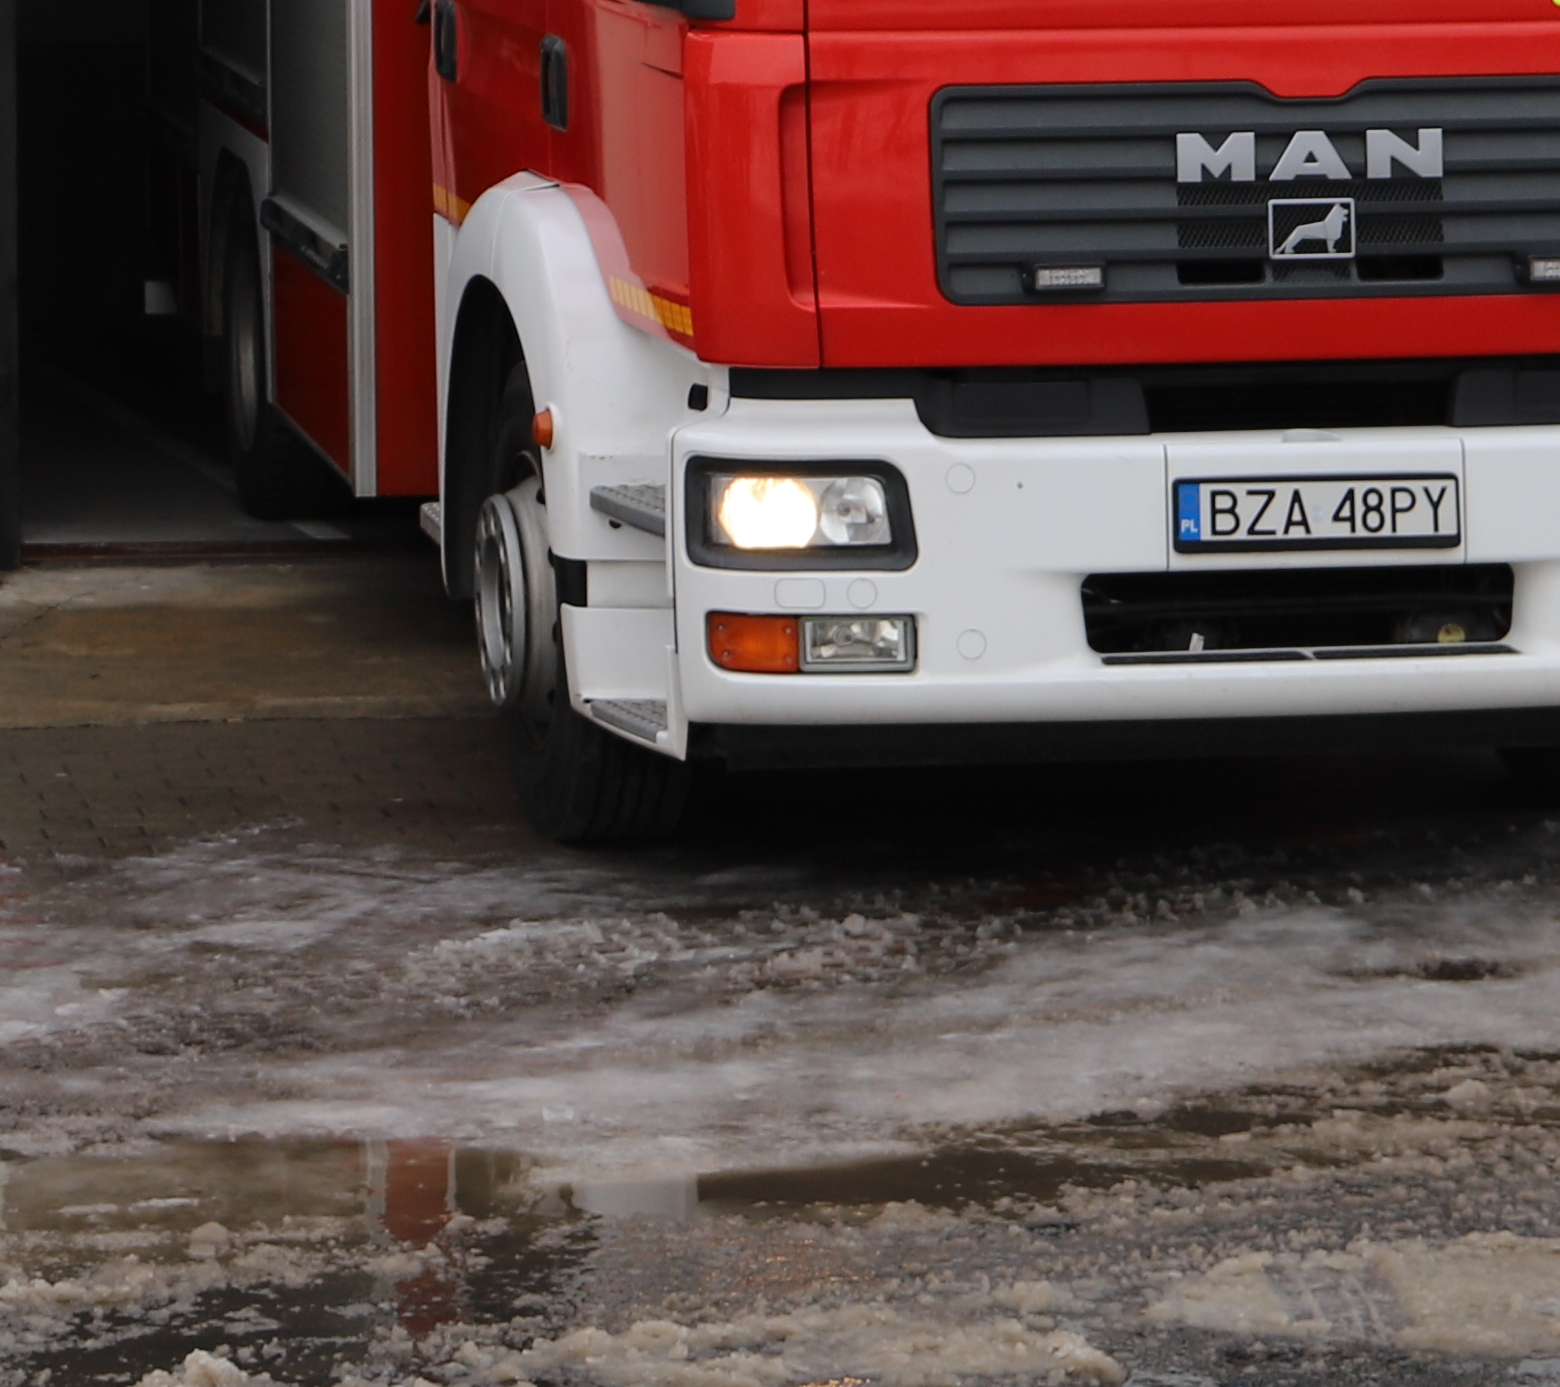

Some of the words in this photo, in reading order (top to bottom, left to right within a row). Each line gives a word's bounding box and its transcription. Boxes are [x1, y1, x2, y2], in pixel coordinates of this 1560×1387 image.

[1175, 127, 1444, 183] MAN
[1180, 519, 1198, 533] PL
[1209, 488, 1312, 536] BZA
[1331, 485, 1448, 534] 48PY
